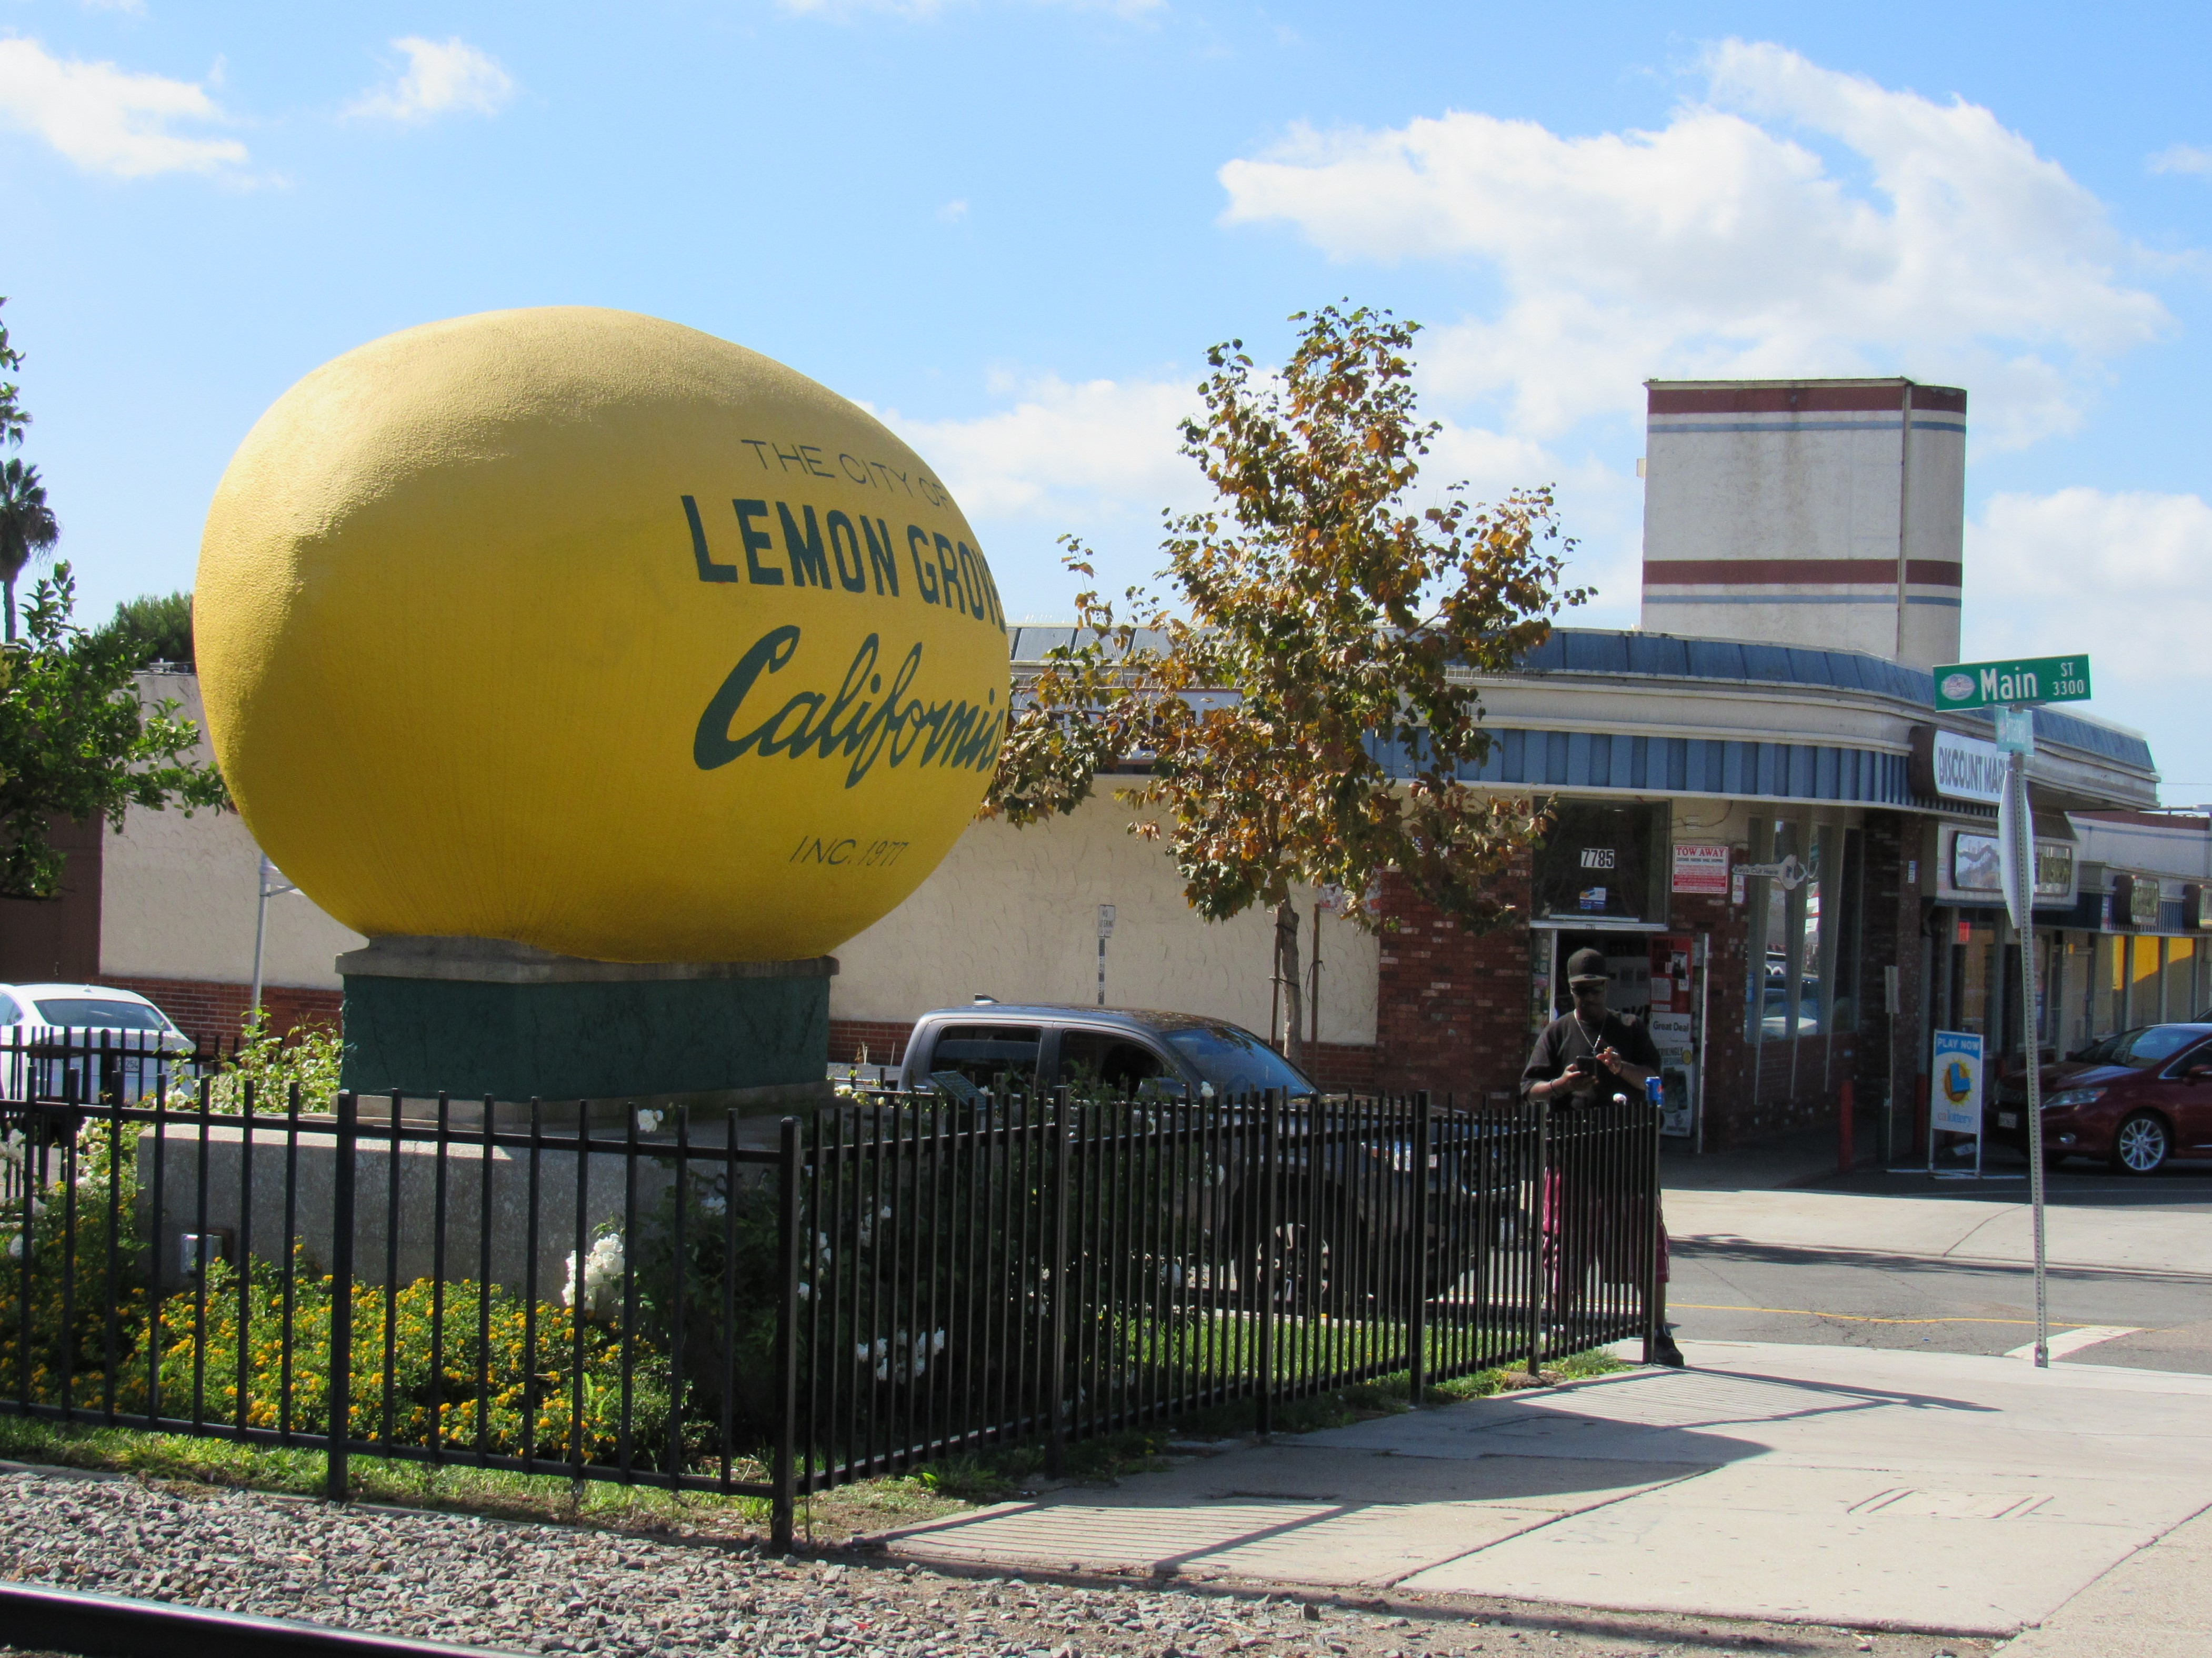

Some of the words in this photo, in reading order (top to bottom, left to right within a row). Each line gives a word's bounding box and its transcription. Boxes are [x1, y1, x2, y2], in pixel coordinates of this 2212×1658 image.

[740, 439, 835, 478] THE
[839, 453, 914, 498] CITY
[918, 477, 949, 510] OF
[680, 495, 899, 598] LEMON
[2060, 662, 2075, 677] ST
[1980, 666, 2038, 701] Main
[2053, 679, 2085, 696] 3300
[693, 625, 1005, 789] California
[1938, 746, 1983, 792] DISCOUNT
[789, 835, 857, 865] INC.
[857, 840, 910, 866] 1977
[1583, 849, 1614, 867] 7785
[1676, 847, 1697, 856] TOW
[1698, 848, 1725, 858] AWAY
[1653, 1021, 1672, 1031] Great
[1674, 1022, 1689, 1032] Deal
[1937, 1037, 1958, 1049] PLAY
[1960, 1039, 1979, 1051] NOW
